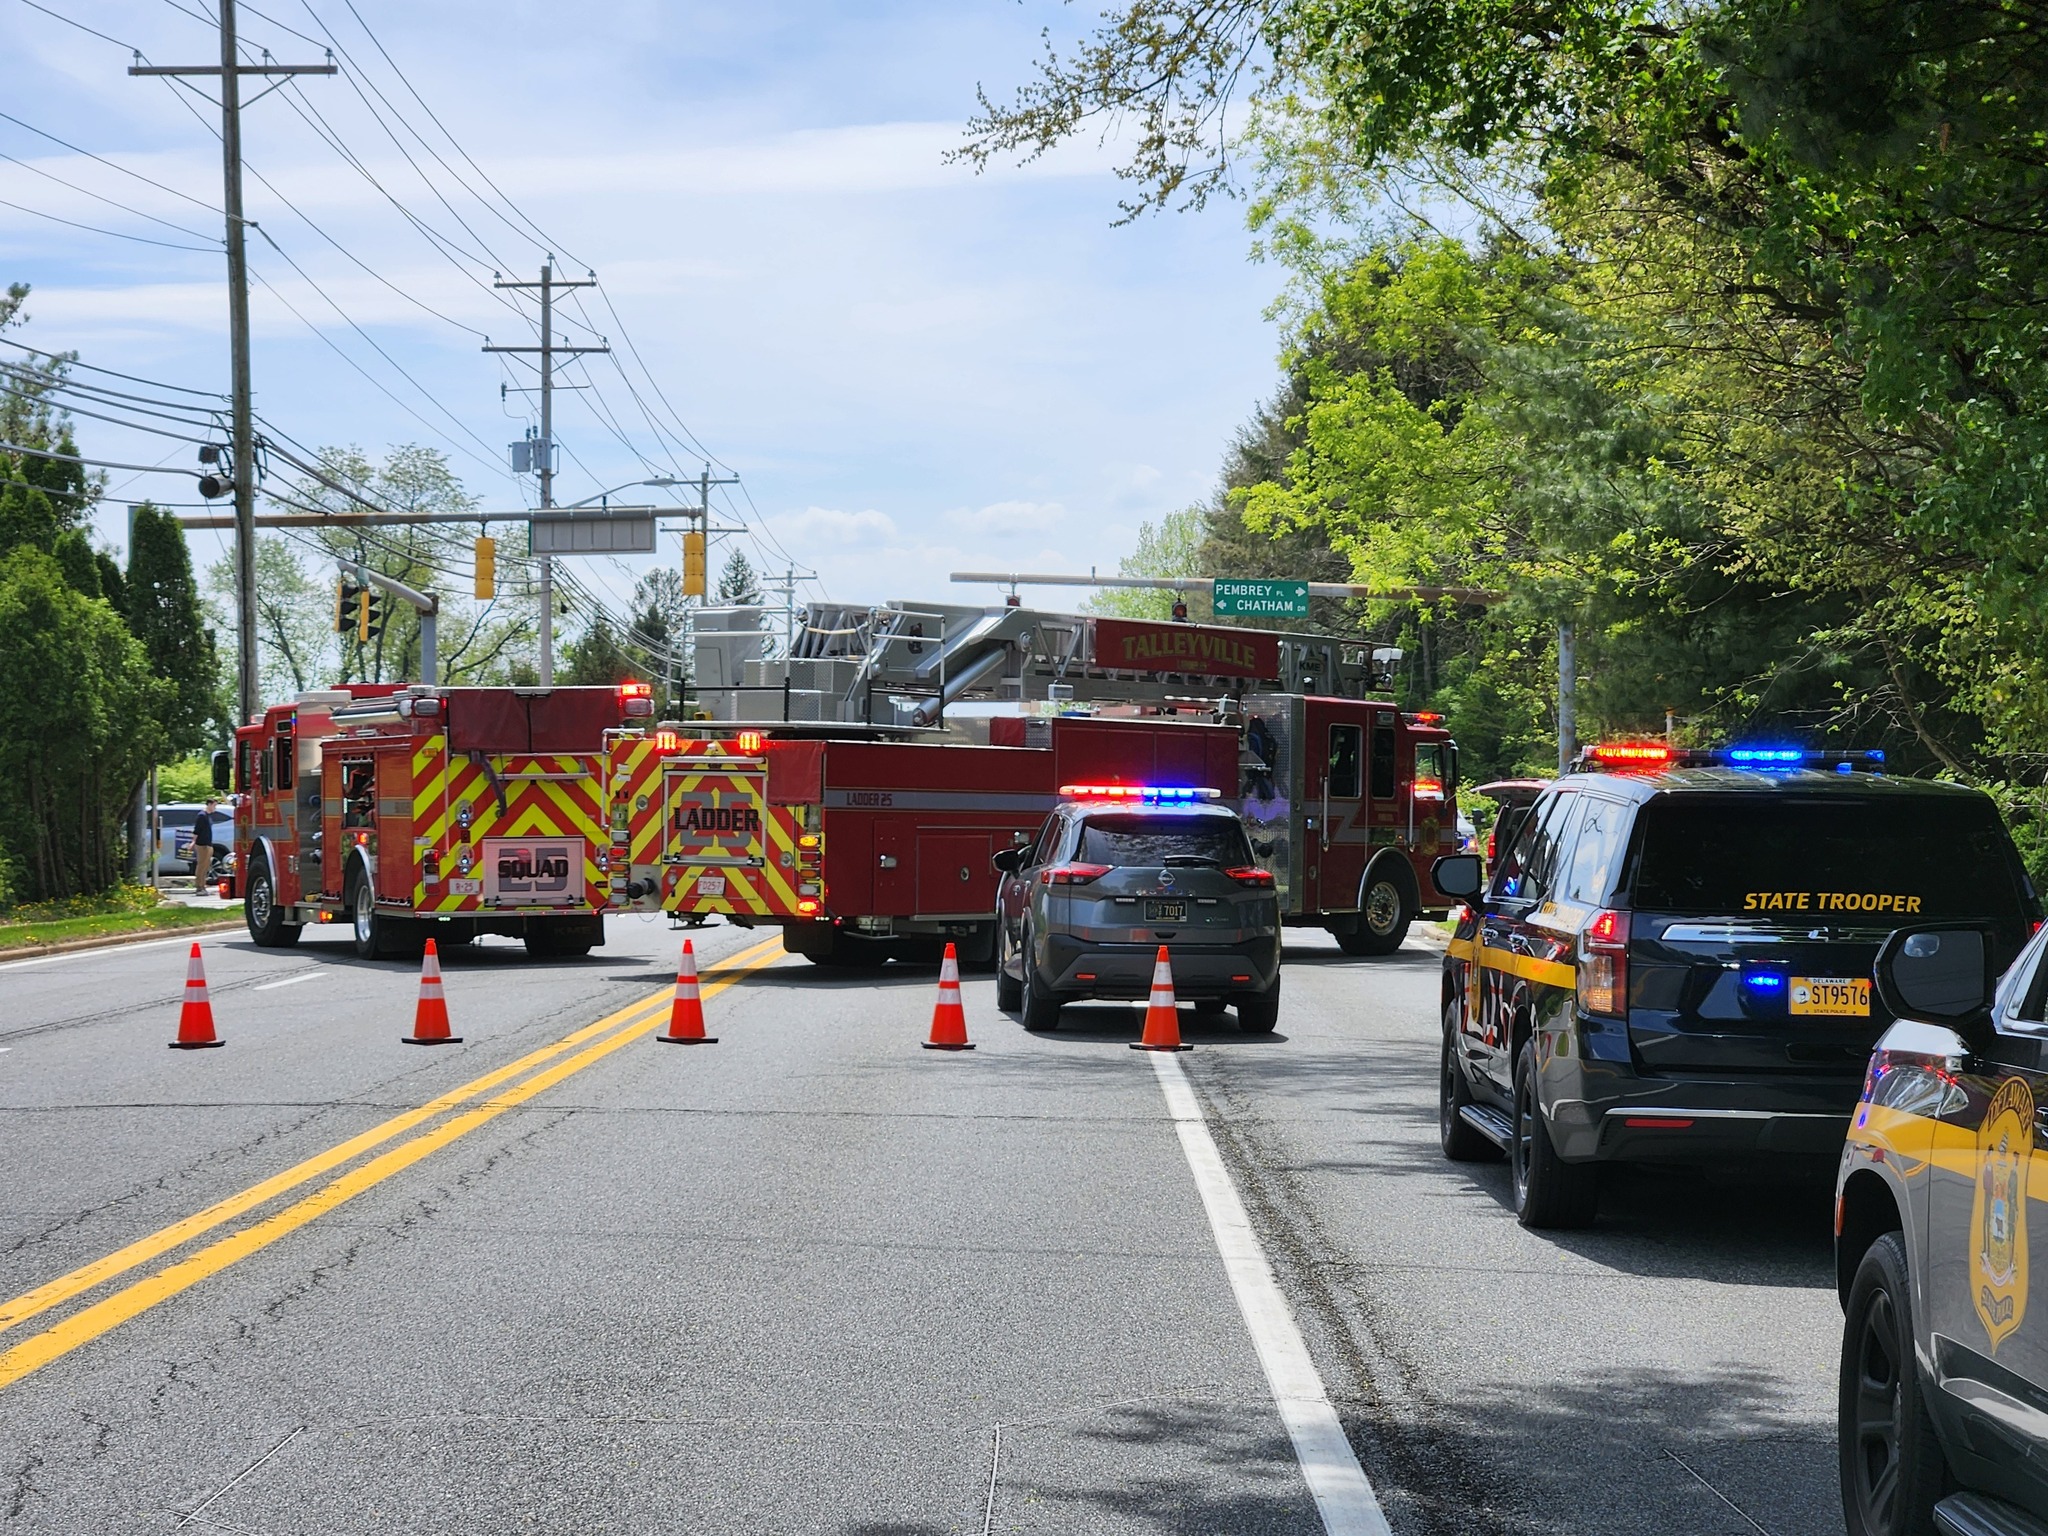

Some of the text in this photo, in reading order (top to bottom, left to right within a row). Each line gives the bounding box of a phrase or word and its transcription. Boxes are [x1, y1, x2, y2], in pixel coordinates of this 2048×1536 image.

[1215, 584, 1272, 596] PEMBREY
[1236, 600, 1293, 611] CHATHAM
[1122, 632, 1255, 669] TALLEYVILLE
[846, 792, 893, 807] LADDER 25
[674, 807, 758, 831] LADDER
[498, 859, 568, 880] SQUAD
[1163, 905, 1184, 917] 7017
[1743, 892, 1921, 913] STATE TROOPER
[1812, 985, 1868, 1005] ST9576
